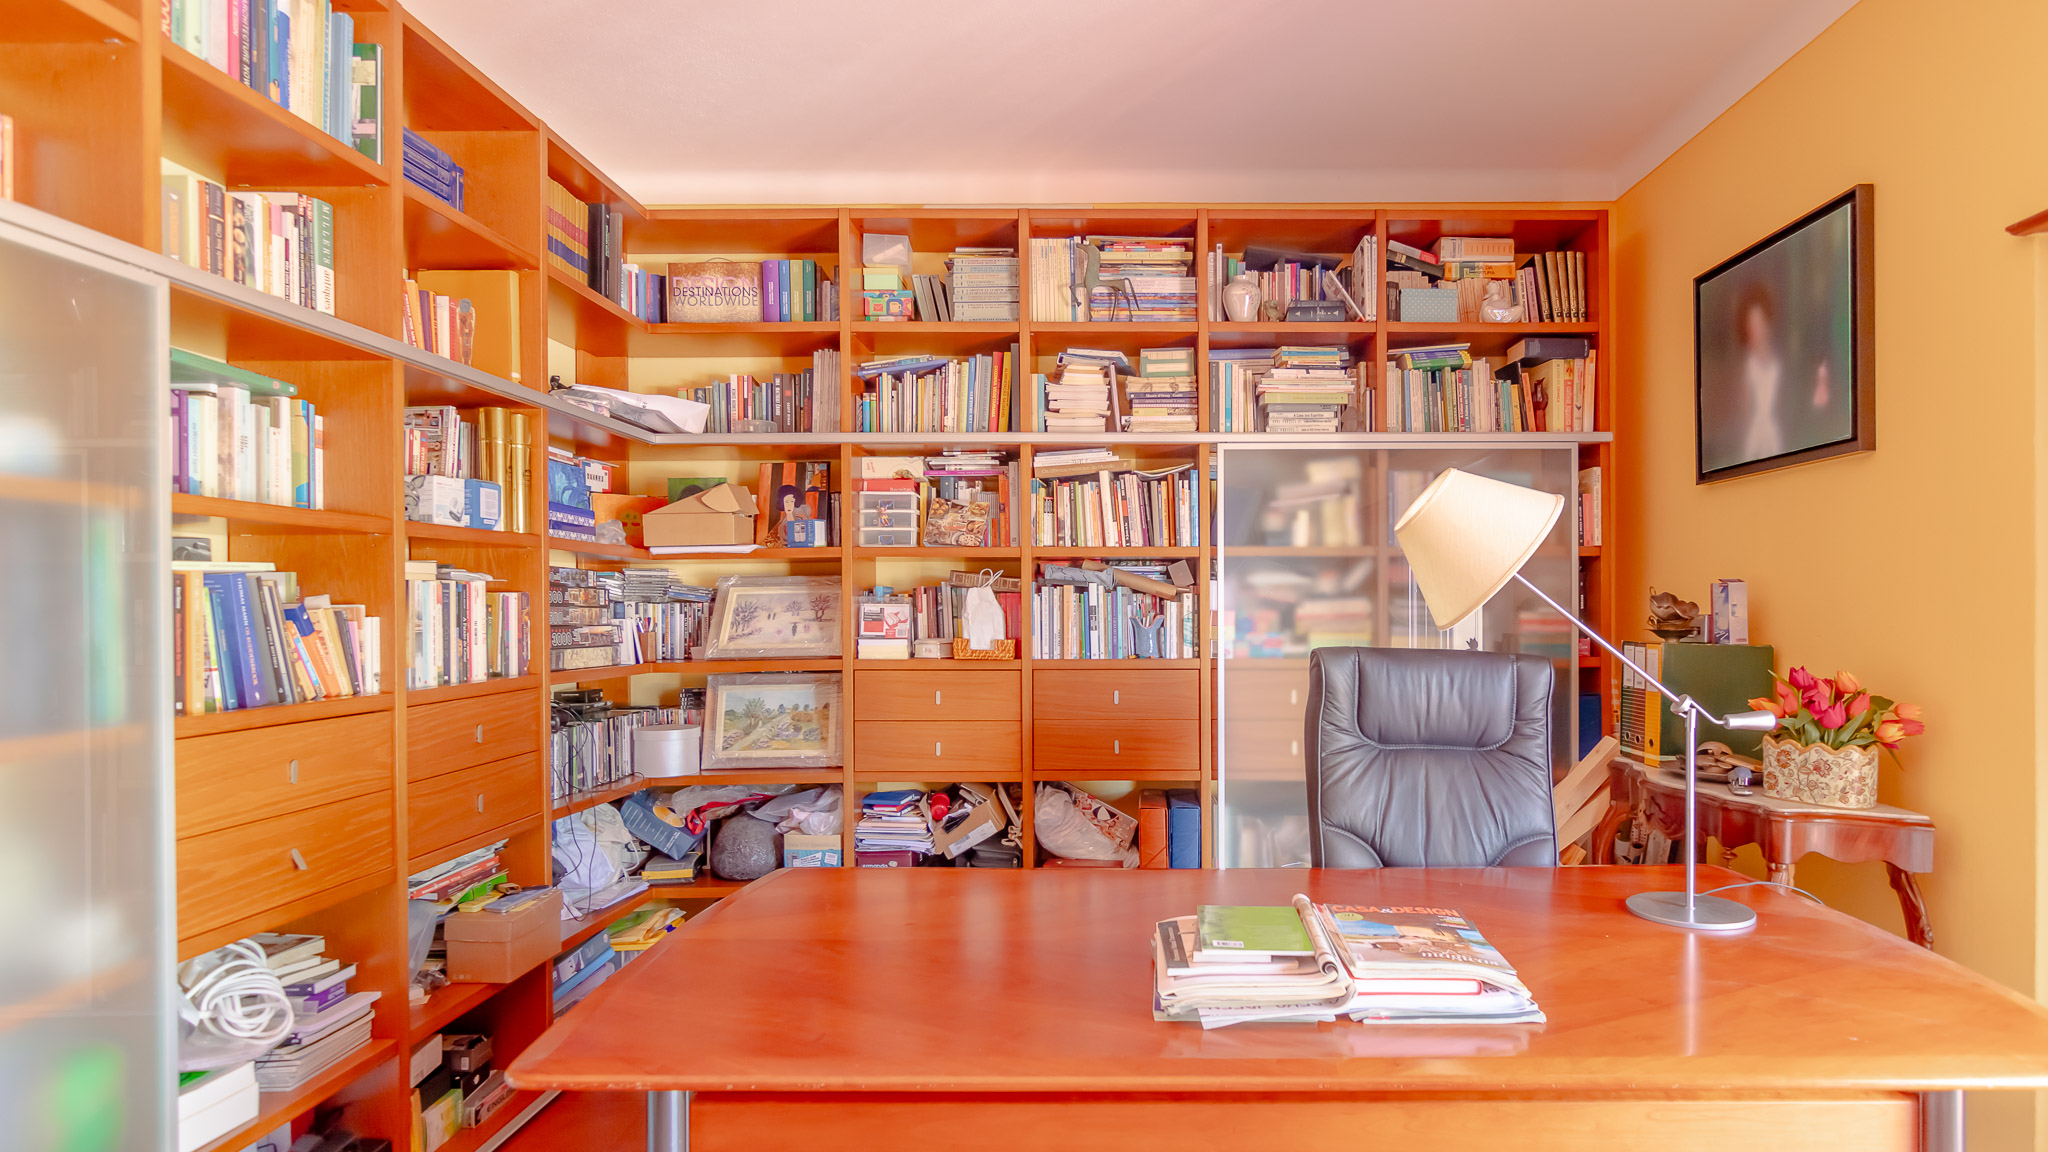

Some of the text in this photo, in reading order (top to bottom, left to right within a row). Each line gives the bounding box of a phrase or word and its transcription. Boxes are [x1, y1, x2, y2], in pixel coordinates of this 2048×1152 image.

[240, 0, 252, 89] ARCHITECTURE NOW
[321, 204, 332, 310] MILLER'S antiques
[673, 286, 759, 297] DESTINATIONS
[674, 295, 759, 307] WORLDWIDE
[236, 577, 247, 605] THOMAS
[241, 605, 250, 626] MANN
[1331, 904, 1461, 917] CASA&DESIGN
